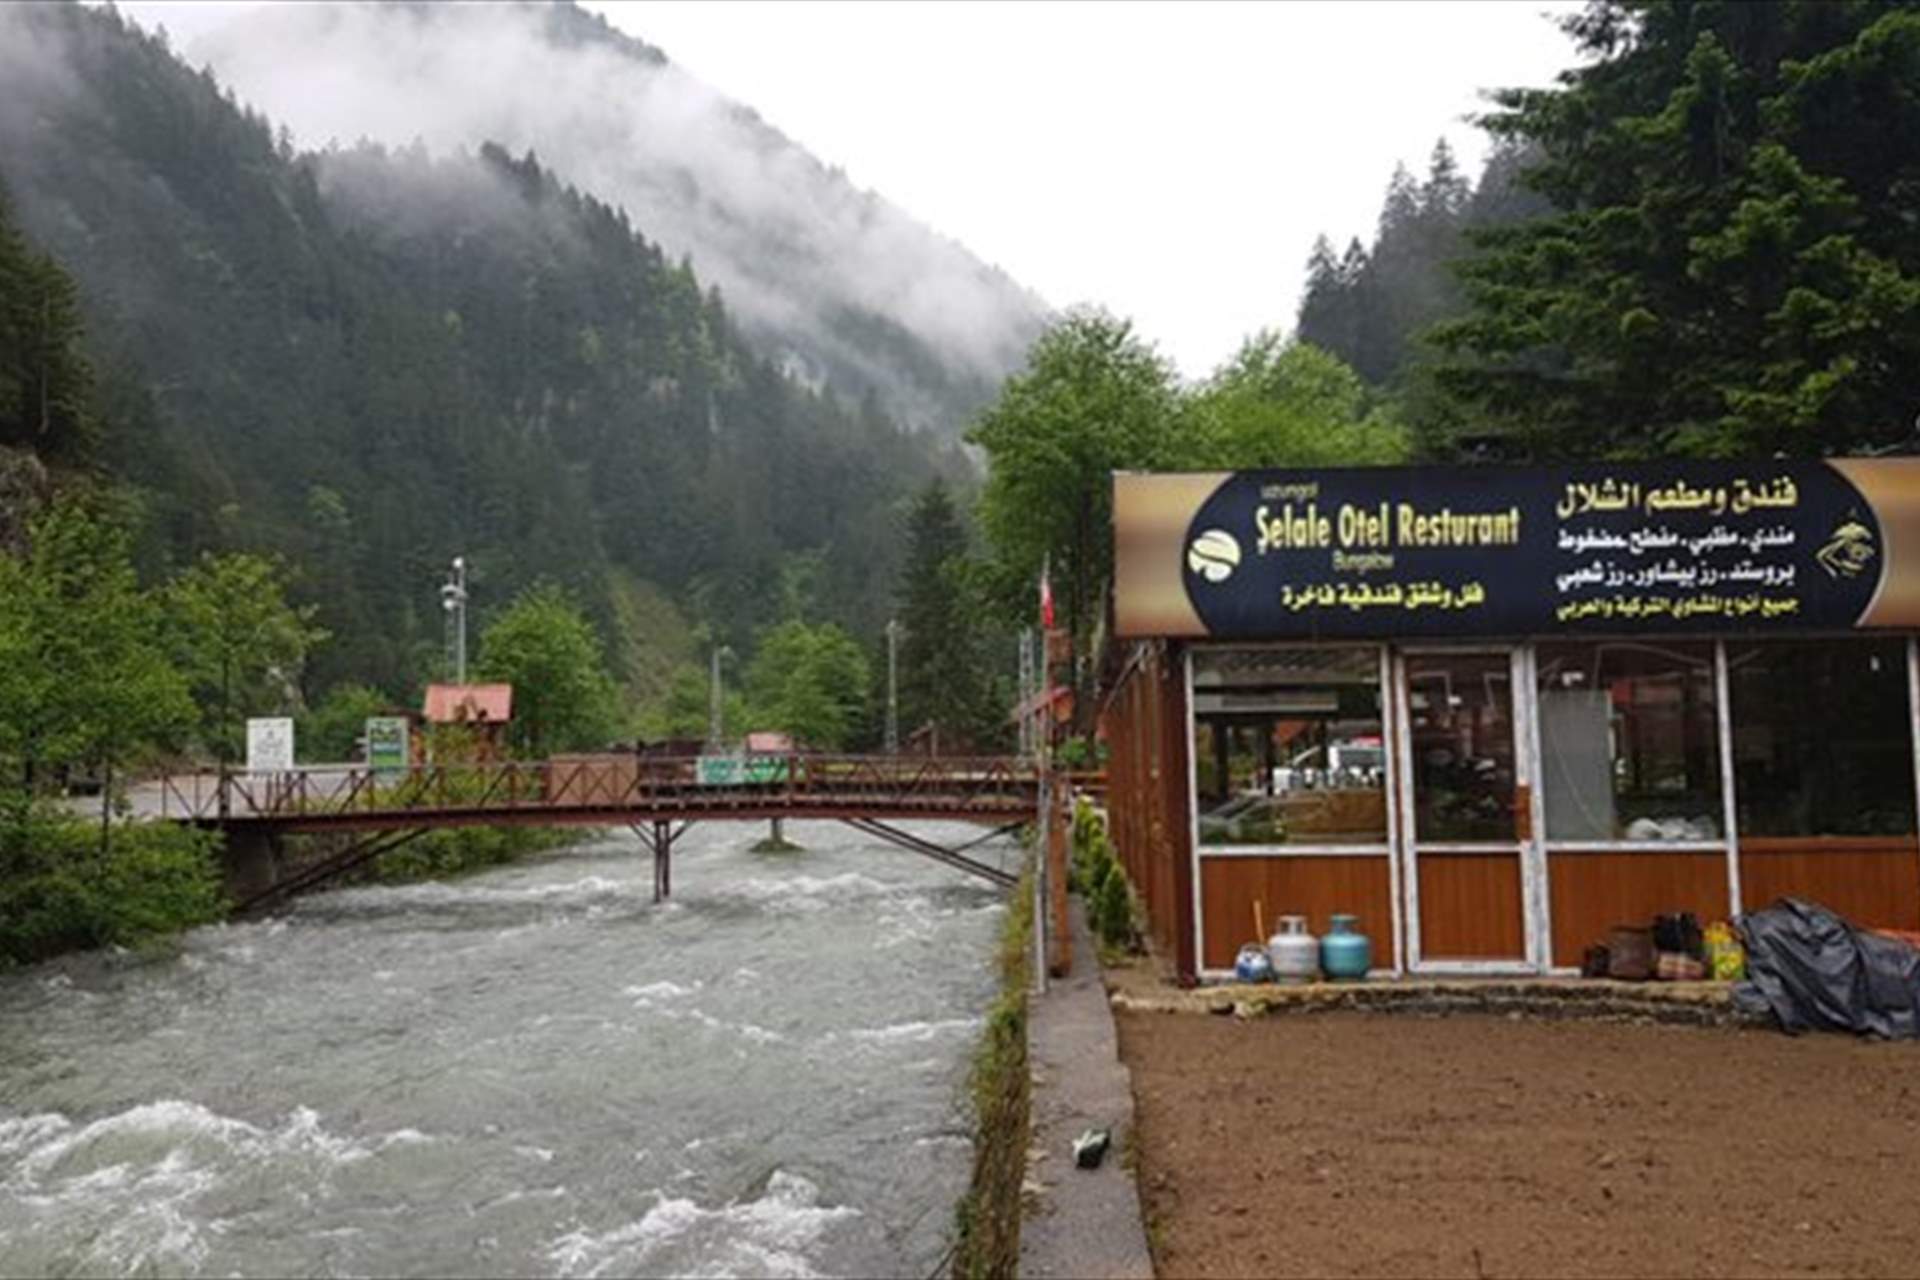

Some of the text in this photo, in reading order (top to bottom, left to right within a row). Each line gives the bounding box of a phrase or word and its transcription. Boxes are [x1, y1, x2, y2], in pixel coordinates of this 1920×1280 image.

[1556, 476, 1797, 518] فندق ومطعم الشلال
[1256, 503, 1519, 554] Şelale Otel Resturant
